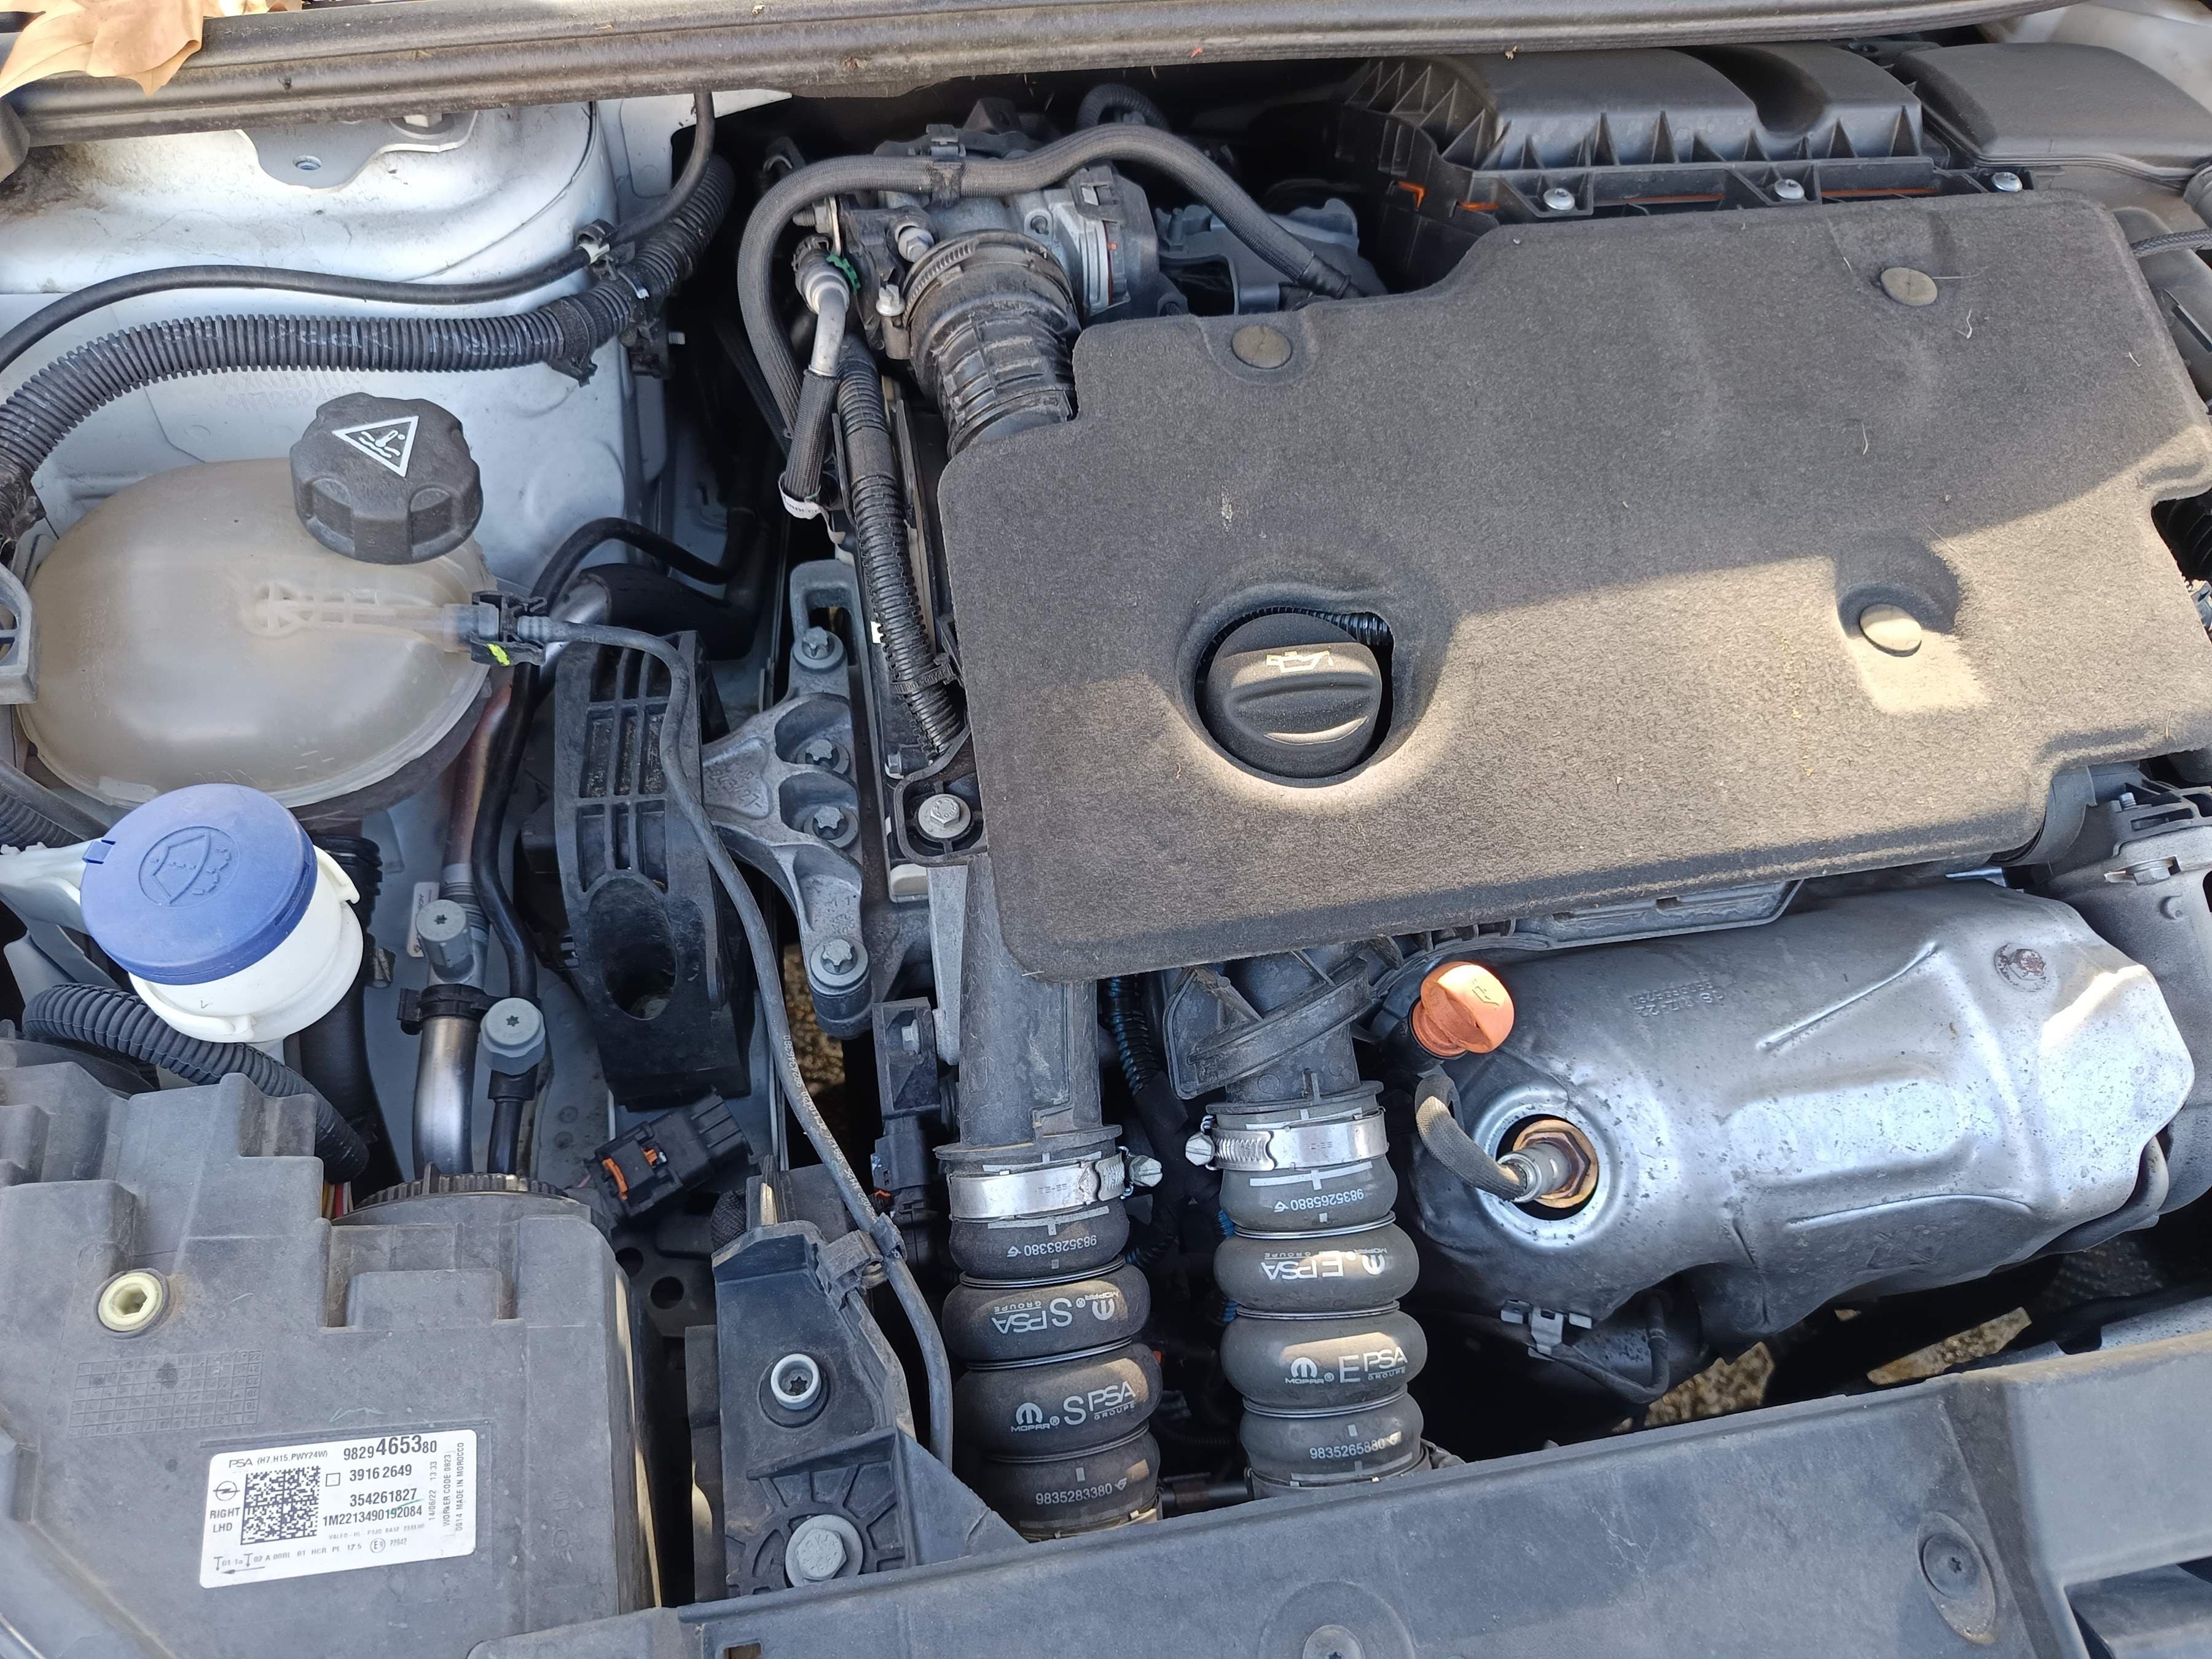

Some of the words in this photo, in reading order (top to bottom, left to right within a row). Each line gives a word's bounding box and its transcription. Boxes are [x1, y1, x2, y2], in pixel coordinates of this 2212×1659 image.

[1290, 1188, 1365, 1211] 9835265880
[1024, 1235, 1097, 1257] 9835283380
[1261, 1260, 1318, 1281] PSA
[994, 1301, 1041, 1312] GROUPE
[1049, 1298, 1073, 1327] S
[992, 1310, 1048, 1334] PSA
[1338, 1354, 1361, 1382] E
[1363, 1346, 1408, 1372] PSA
[1367, 1367, 1406, 1381] GROUPE
[1011, 1423, 1051, 1432] MOPAR
[1063, 1395, 1087, 1426] S
[1088, 1381, 1136, 1411] PSA
[1094, 1403, 1135, 1421] GROUPE
[343, 1435, 437, 1461] 9829465380
[1309, 1438, 1385, 1460] 9835265880
[229, 1457, 253, 1469] PSA
[350, 1488, 417, 1507] 354261827
[1035, 1483, 1113, 1505] 9835283380
[210, 1507, 241, 1519] RIGHT
[323, 1505, 422, 1526] 1M2213490192084
[213, 1523, 232, 1533] LHD
